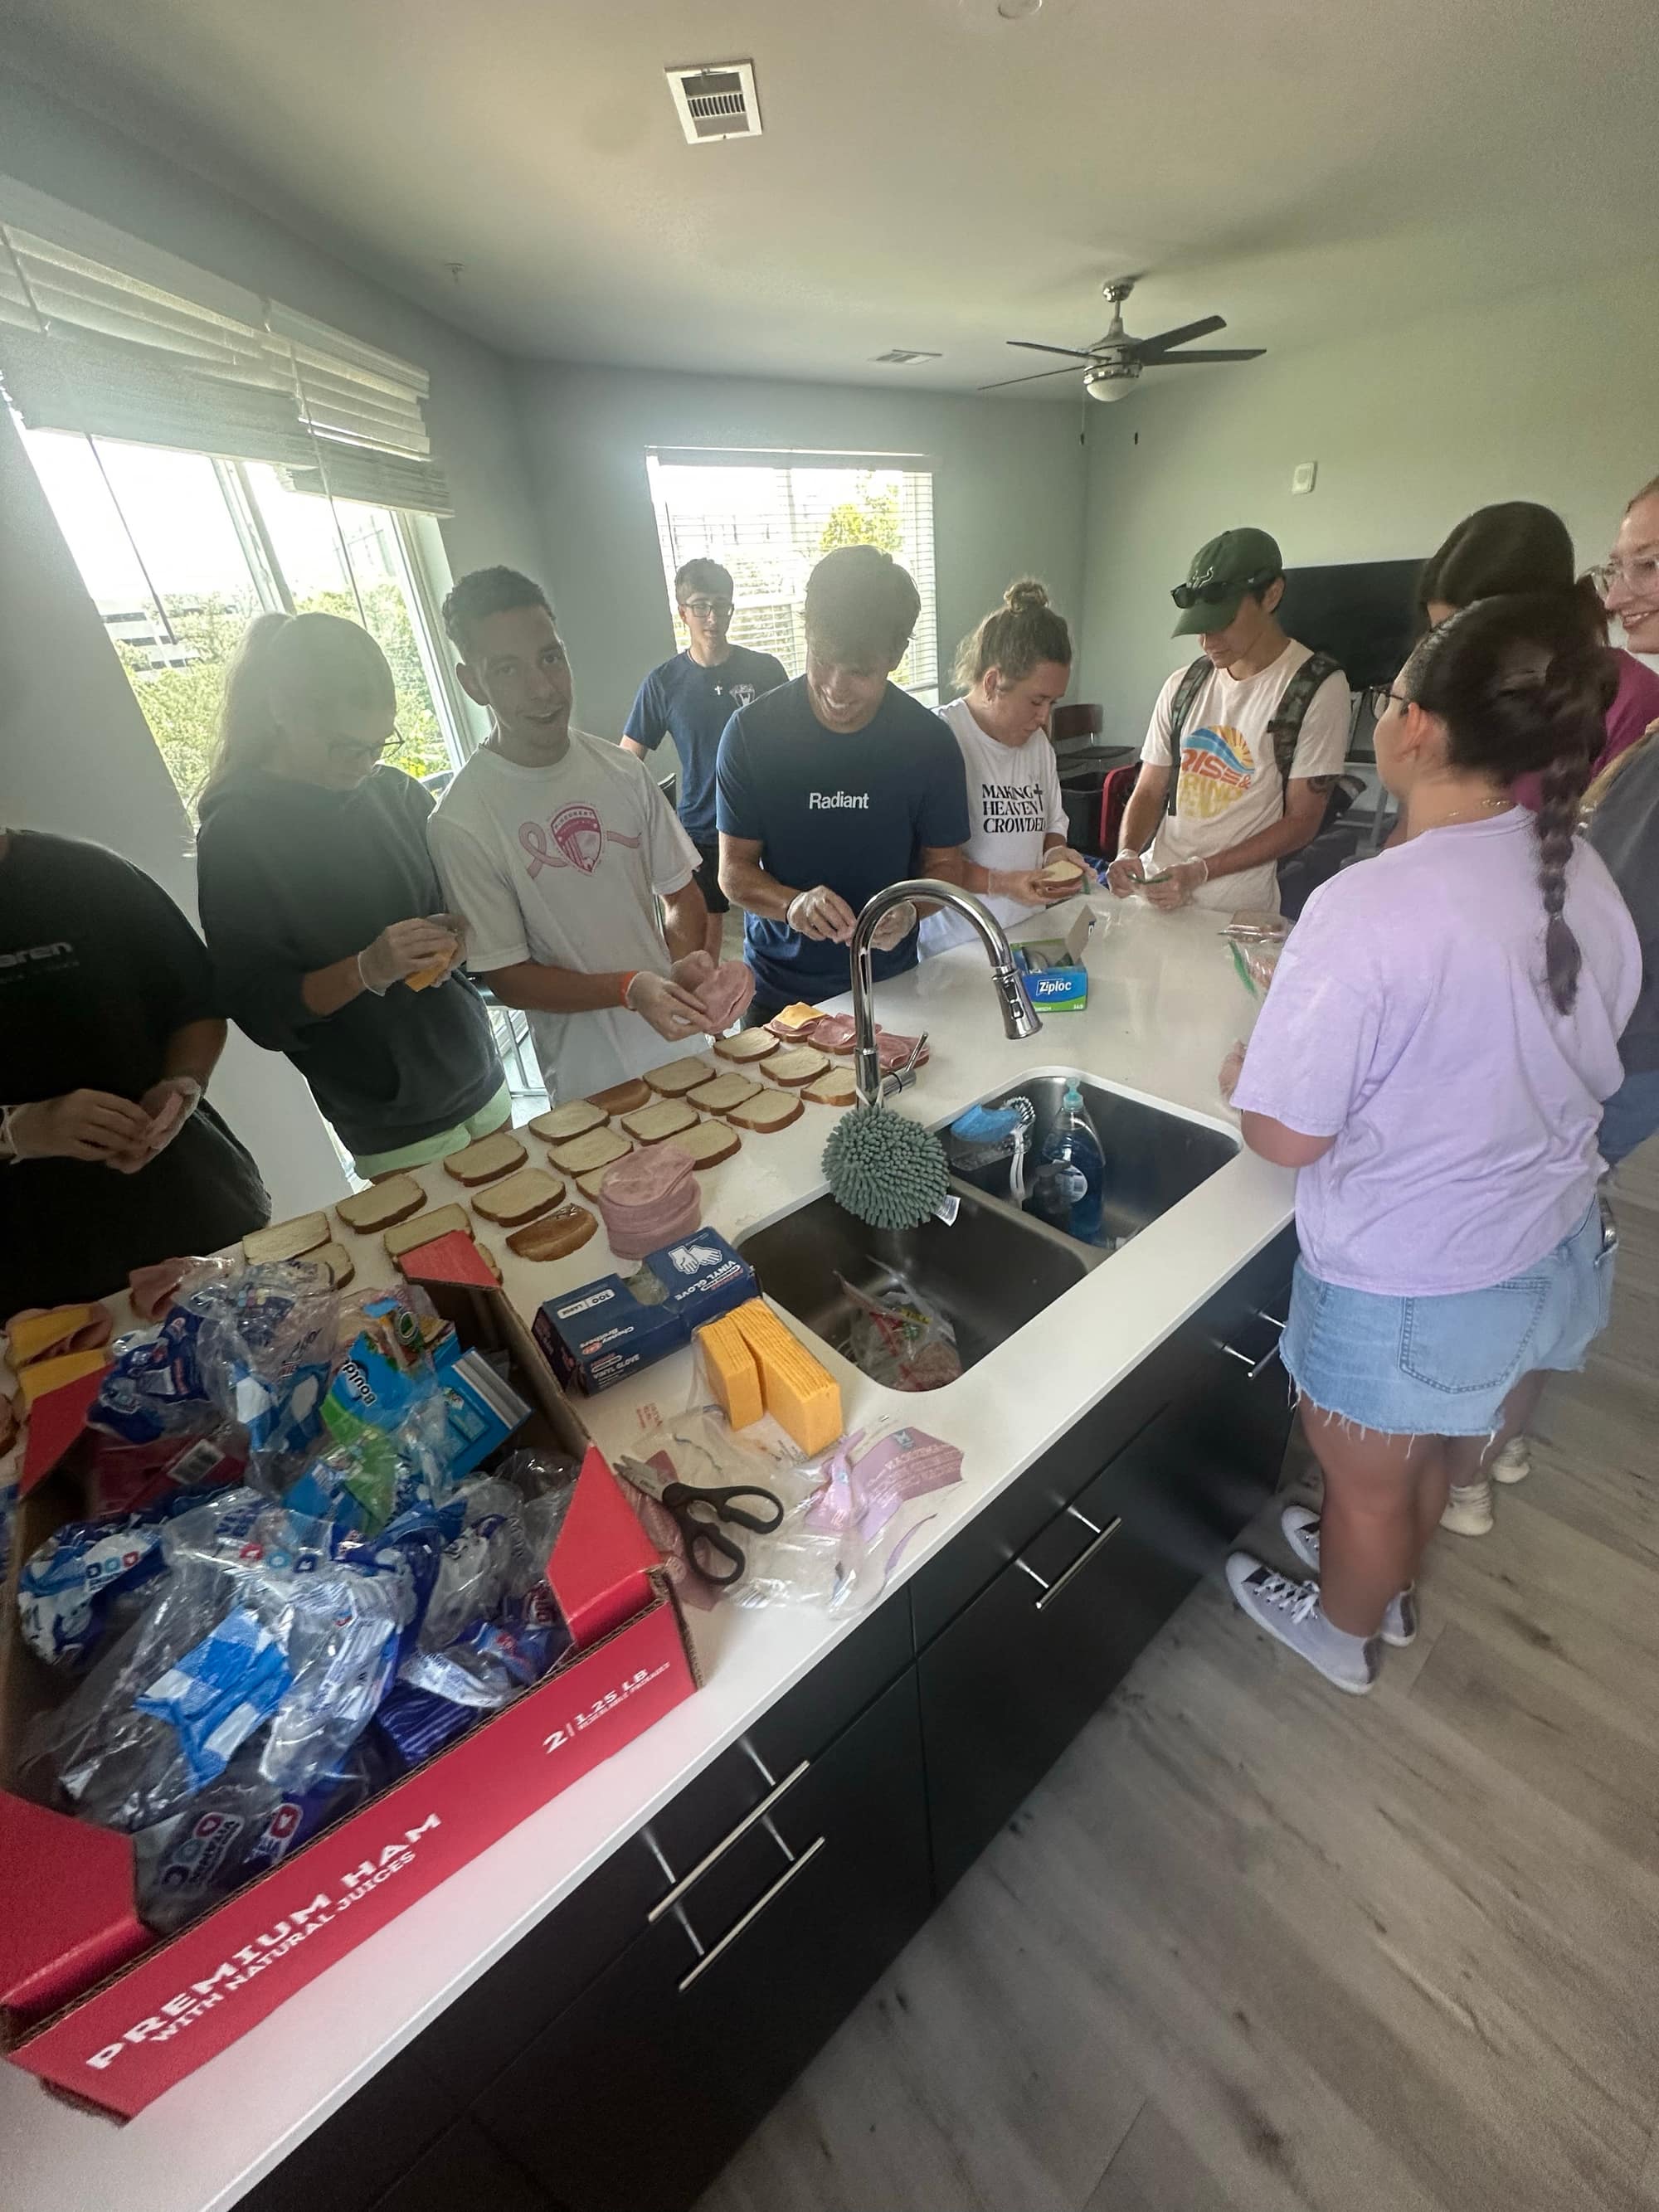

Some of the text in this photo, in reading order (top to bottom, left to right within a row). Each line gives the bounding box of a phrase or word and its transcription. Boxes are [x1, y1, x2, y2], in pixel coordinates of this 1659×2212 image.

[809, 791, 869, 809] Radiant
[983, 800, 1039, 816] HEAVEN
[1039, 980, 1073, 995] Ziploc
[705, 1260, 737, 1281] VINYL
[591, 1291, 611, 1305] 100
[674, 1276, 708, 1300] GLOVE
[542, 1669, 649, 1754] 2 1.25 LB
[86, 1893, 333, 2069] PREMIUM
[340, 1812, 441, 1889] HAM
[149, 1850, 416, 2042] WITH NATURAL JUICES
